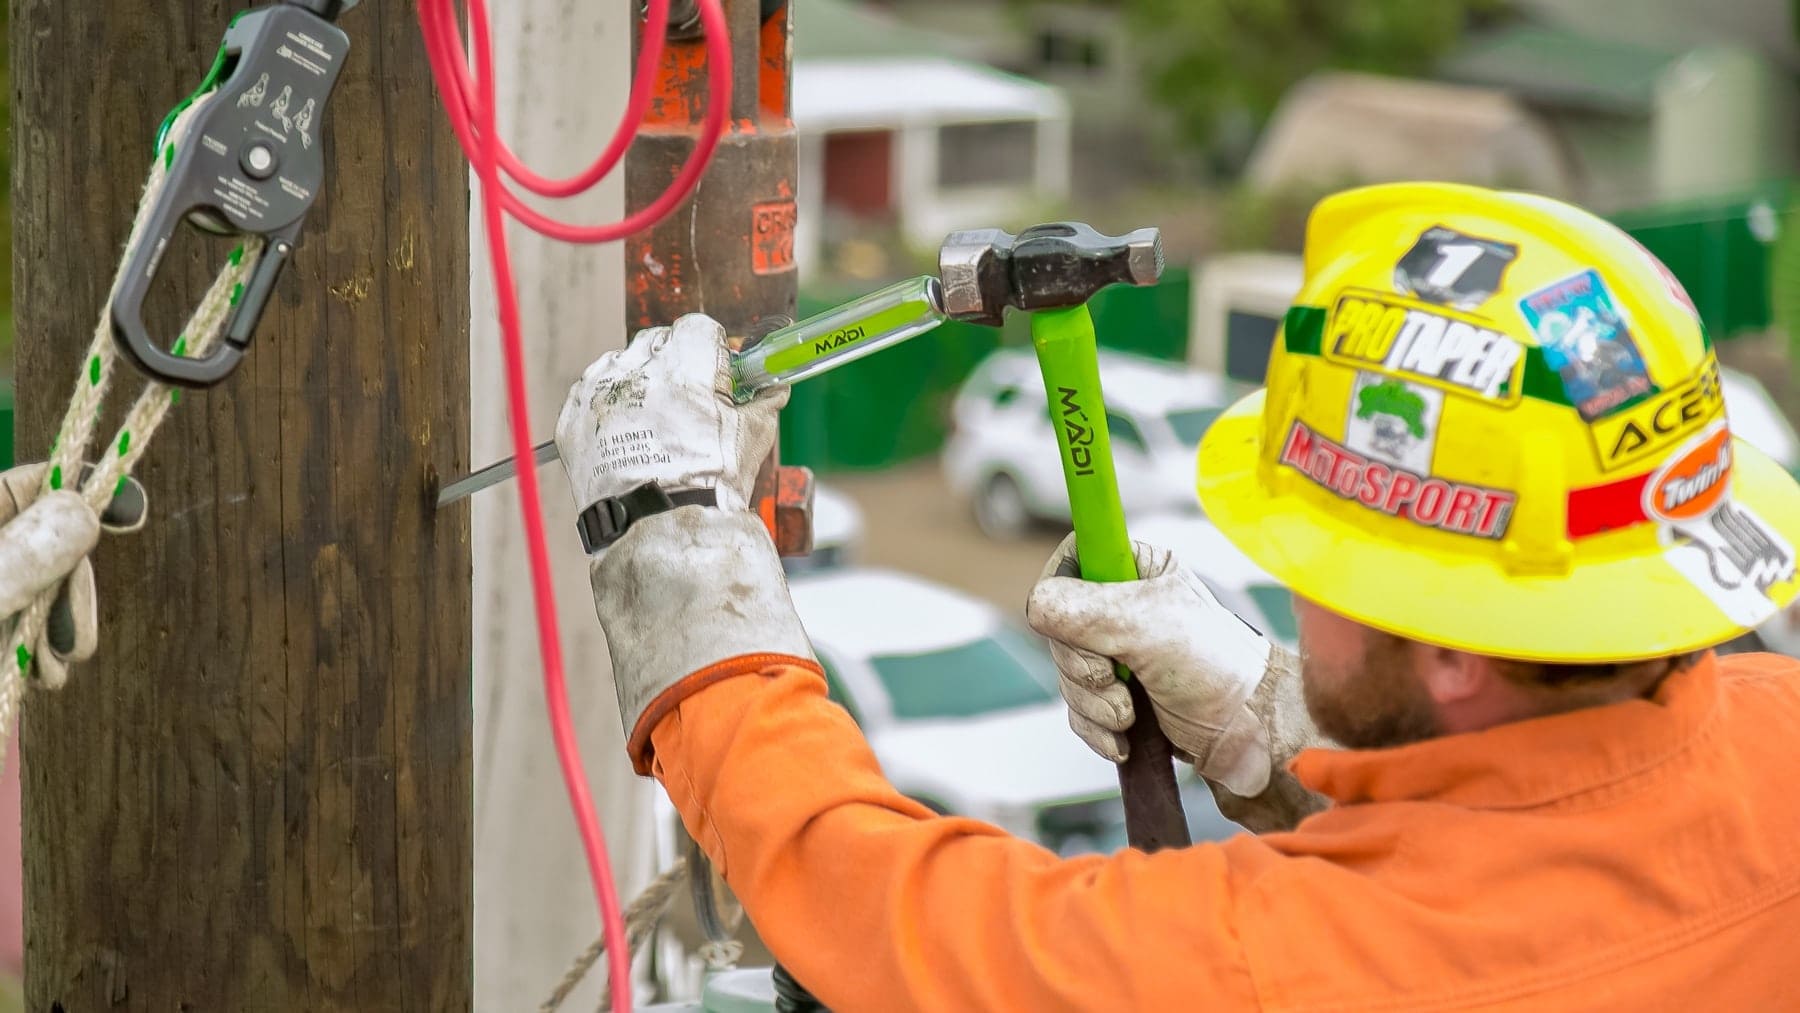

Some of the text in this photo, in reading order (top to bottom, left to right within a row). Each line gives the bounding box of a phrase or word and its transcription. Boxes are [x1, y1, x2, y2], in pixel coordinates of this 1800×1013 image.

[1425, 245, 1486, 288] 1
[815, 326, 865, 354] MADI
[611, 429, 653, 445] LENGTH
[1058, 387, 1094, 476] MADI
